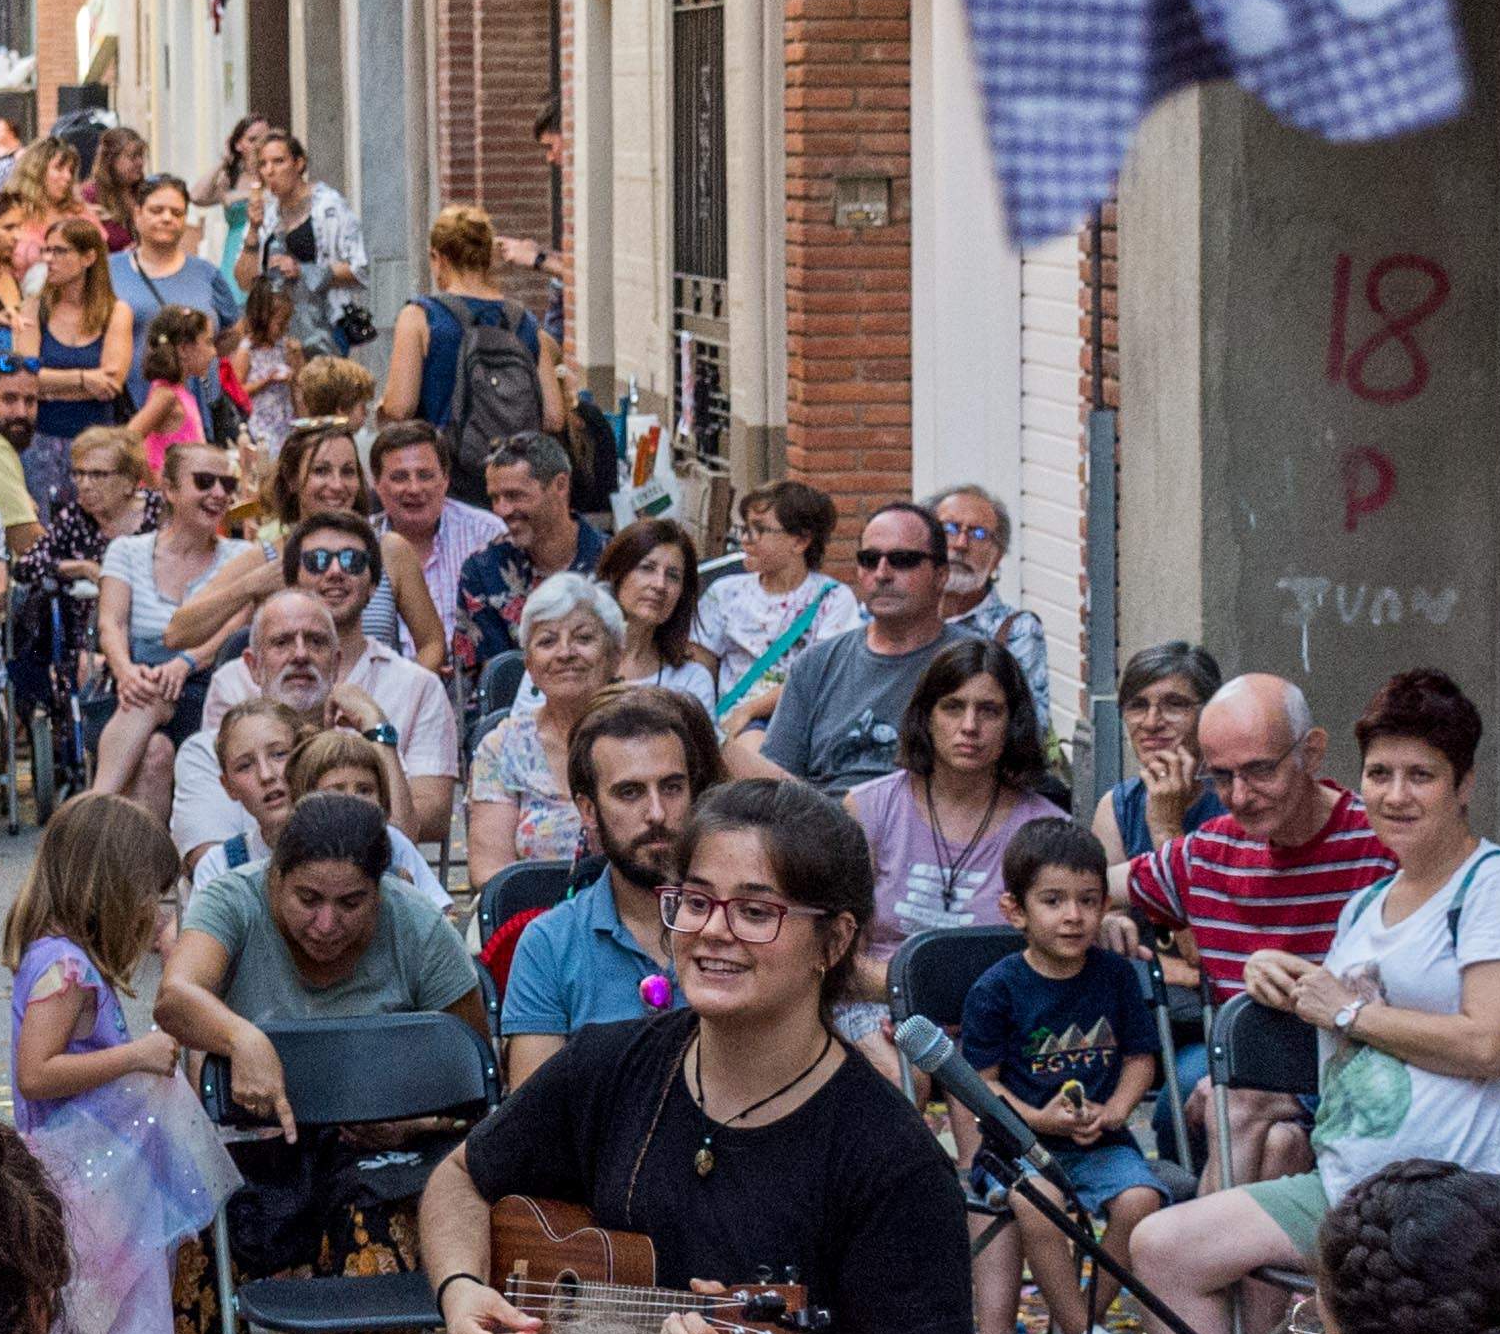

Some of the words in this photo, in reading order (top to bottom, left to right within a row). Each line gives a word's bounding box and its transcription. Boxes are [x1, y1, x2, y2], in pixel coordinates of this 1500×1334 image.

[1325, 252, 1451, 406] 18
[1341, 447, 1396, 533] P
[1031, 1048, 1115, 1075] EGYPT
